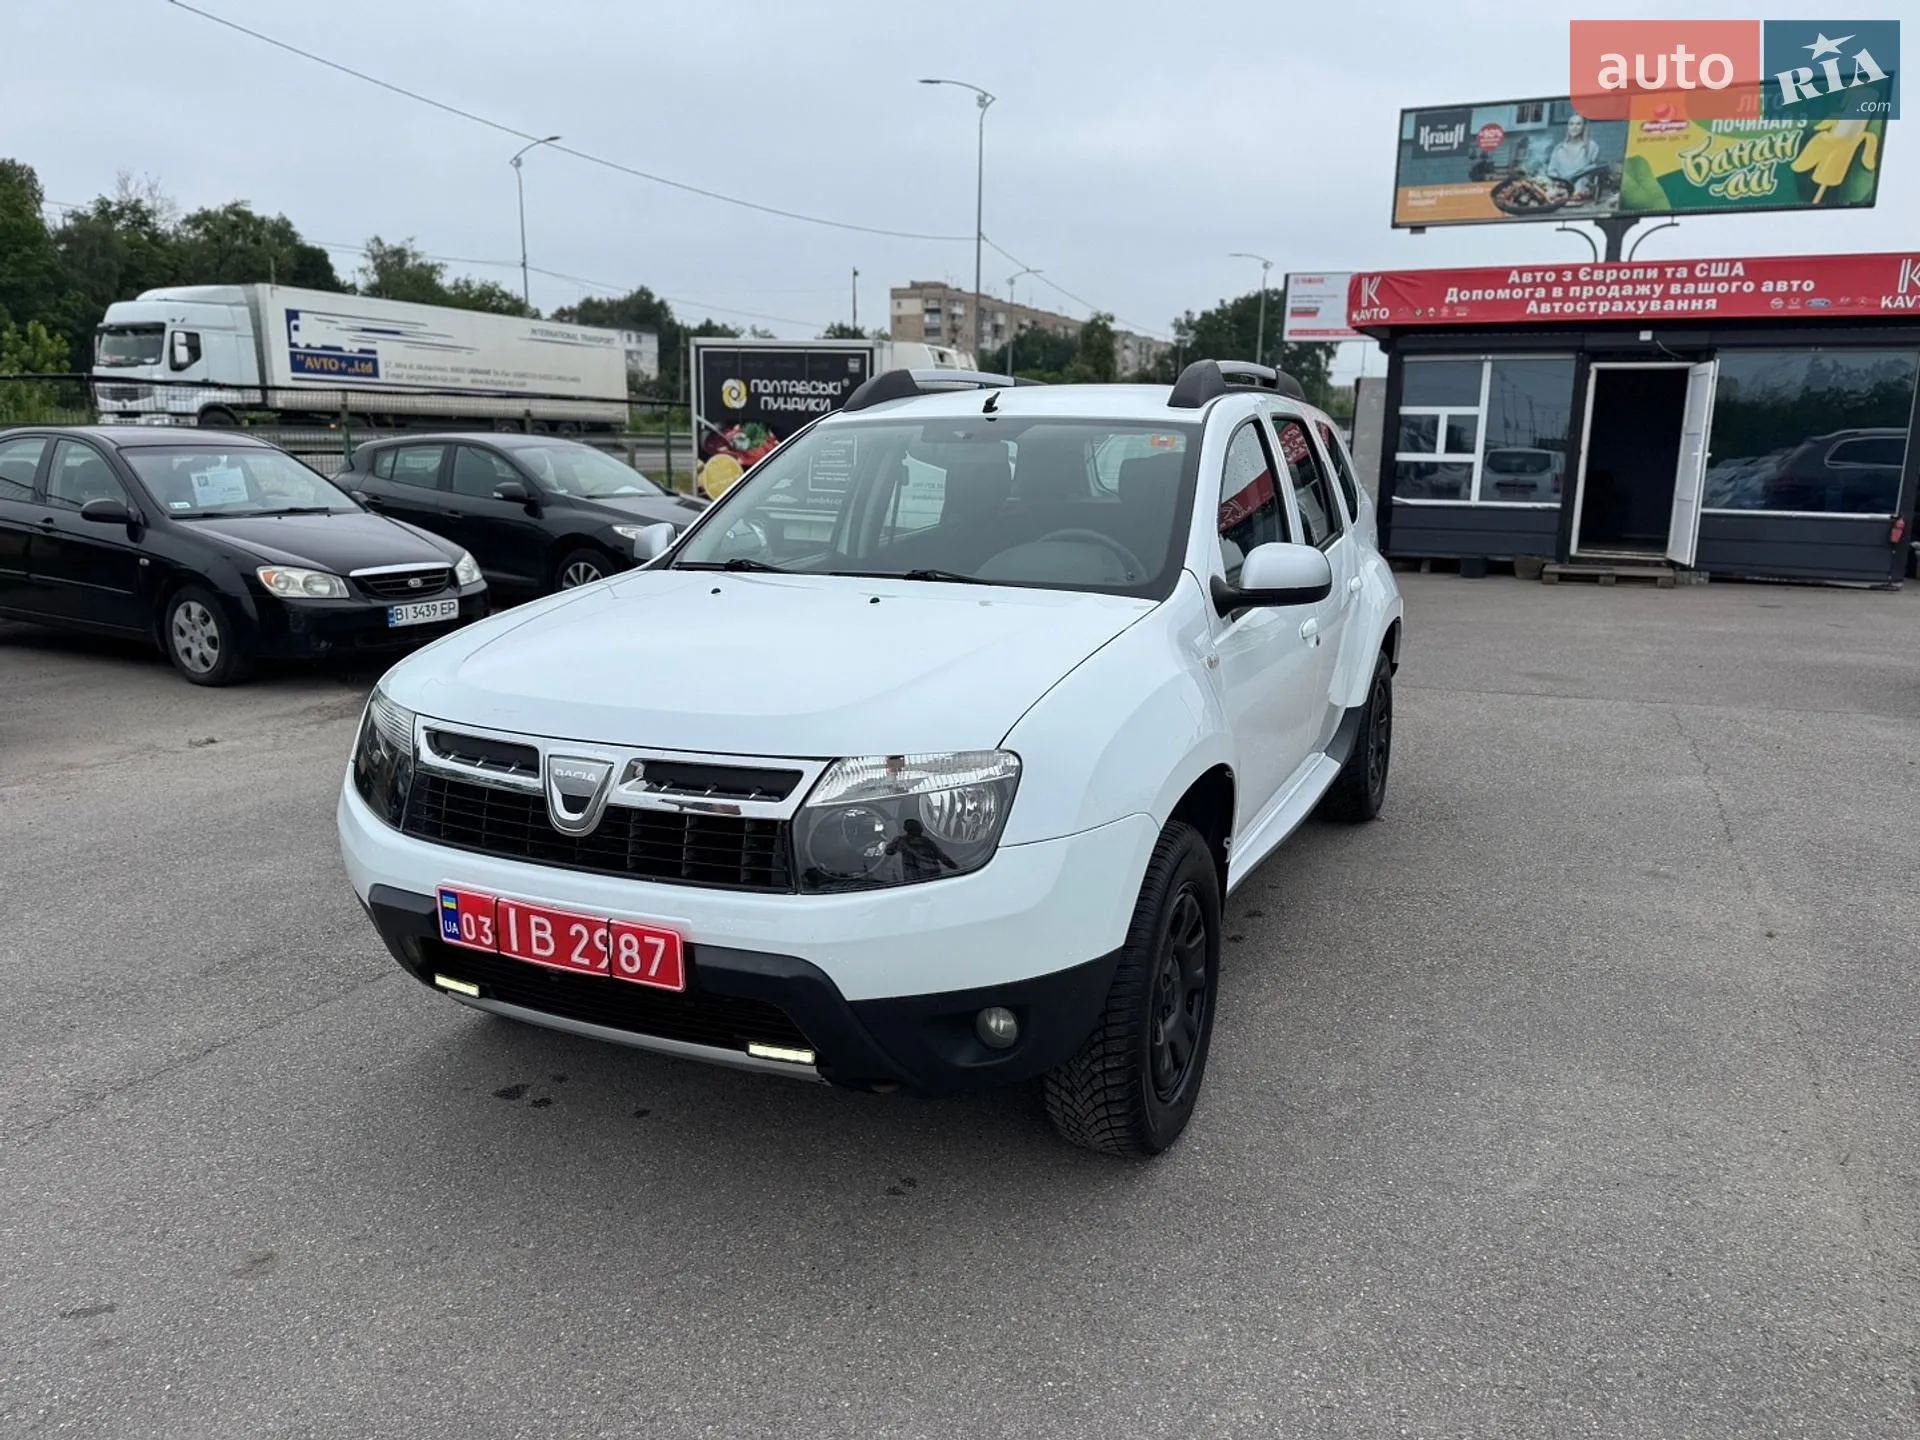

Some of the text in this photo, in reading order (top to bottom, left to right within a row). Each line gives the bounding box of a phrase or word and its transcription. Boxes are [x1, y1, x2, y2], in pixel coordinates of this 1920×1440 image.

[1711, 111, 1794, 133] ПОЧИНАЙ
[1508, 262, 1745, 285] Авто з Європи та США
[1445, 279, 1816, 304] Допомога в продажу вашого авто
[1526, 298, 1718, 316] Автострахування
[1880, 295, 1920, 309] KAV
[1351, 307, 1390, 321] KAVTO
[760, 396, 831, 412] ПУНДИКИ
[412, 604, 438, 619] 3439
[554, 768, 597, 782] DACIA
[444, 922, 460, 935] UA
[461, 912, 494, 946] 03
[569, 924, 666, 978] 2987
